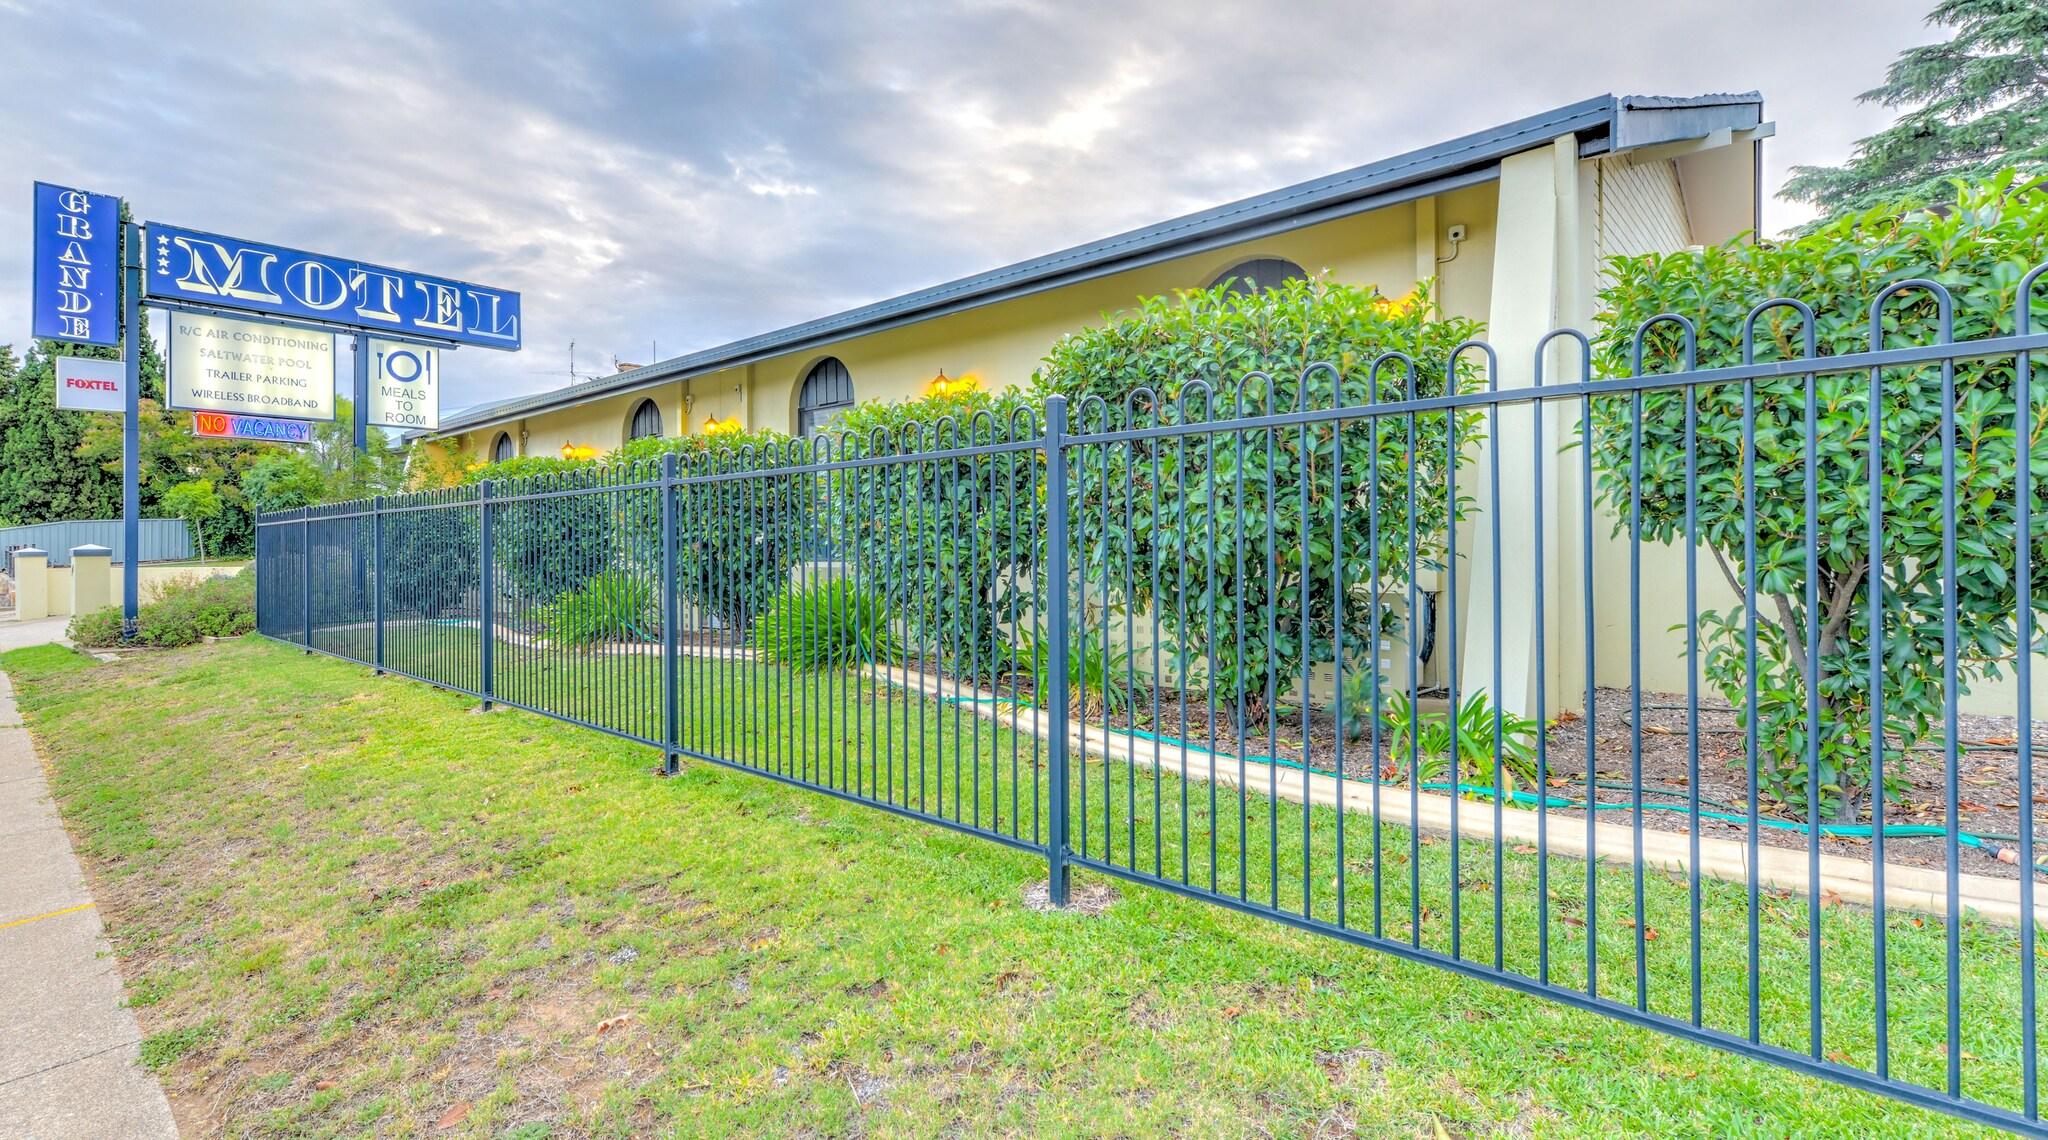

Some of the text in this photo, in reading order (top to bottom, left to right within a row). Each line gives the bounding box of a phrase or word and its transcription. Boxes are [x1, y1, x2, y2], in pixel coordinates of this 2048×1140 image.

[173, 236, 517, 341] MOTEL
[178, 325, 329, 352] R/C AIR CONDITIONING
[199, 347, 312, 370] SALTWATER POOL
[66, 377, 118, 392] FOXTEL
[206, 368, 307, 388] TRAILER PARKING
[191, 388, 318, 409] WIRELESS BROADBAND
[381, 386, 426, 401] MEALS
[395, 400, 413, 412] TO
[199, 415, 308, 441] NO VACANCY
[385, 412, 426, 425] ROOM
